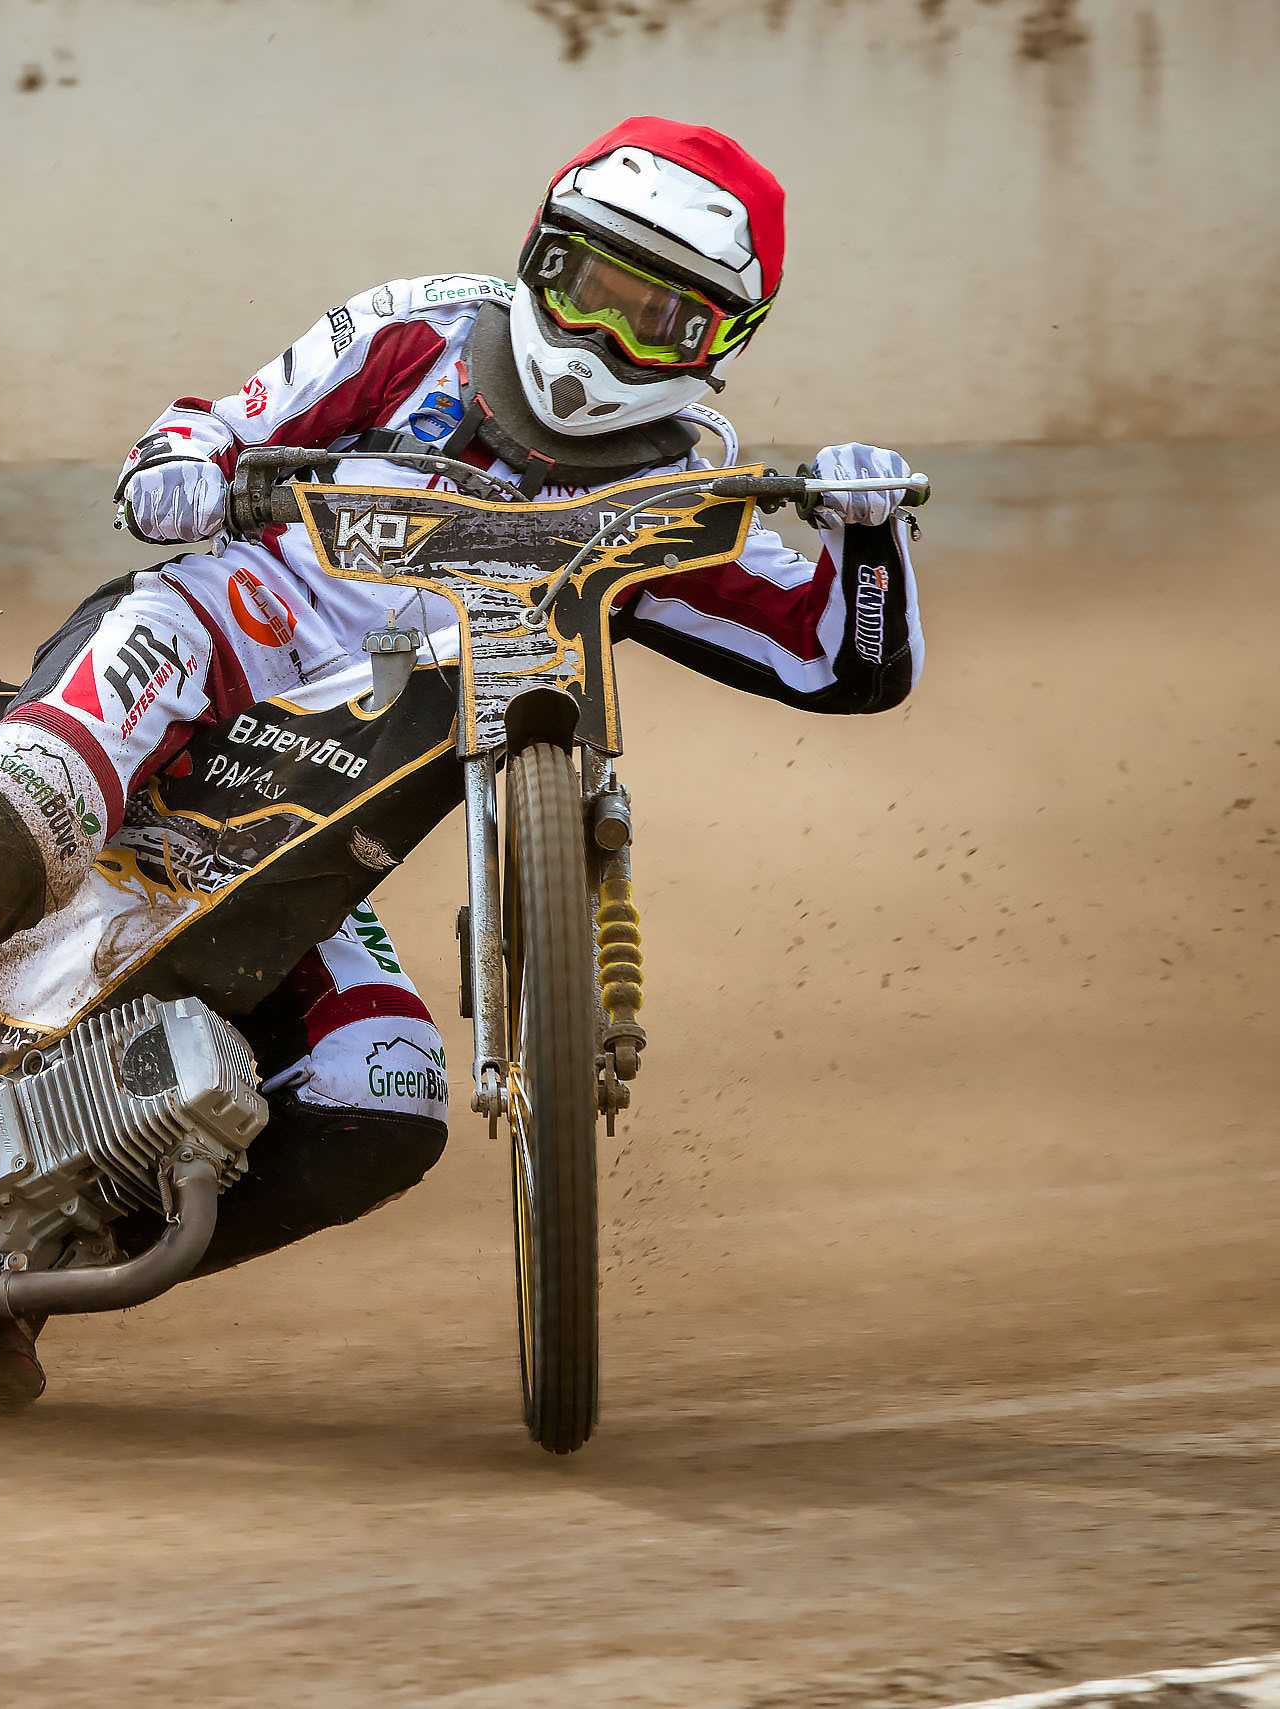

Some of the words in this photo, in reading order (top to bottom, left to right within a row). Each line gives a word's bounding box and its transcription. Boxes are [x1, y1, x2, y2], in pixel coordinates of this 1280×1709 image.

[121, 682, 160, 741] FASTEST
[153, 660, 175, 689] WAY
[186, 654, 198, 676] TO
